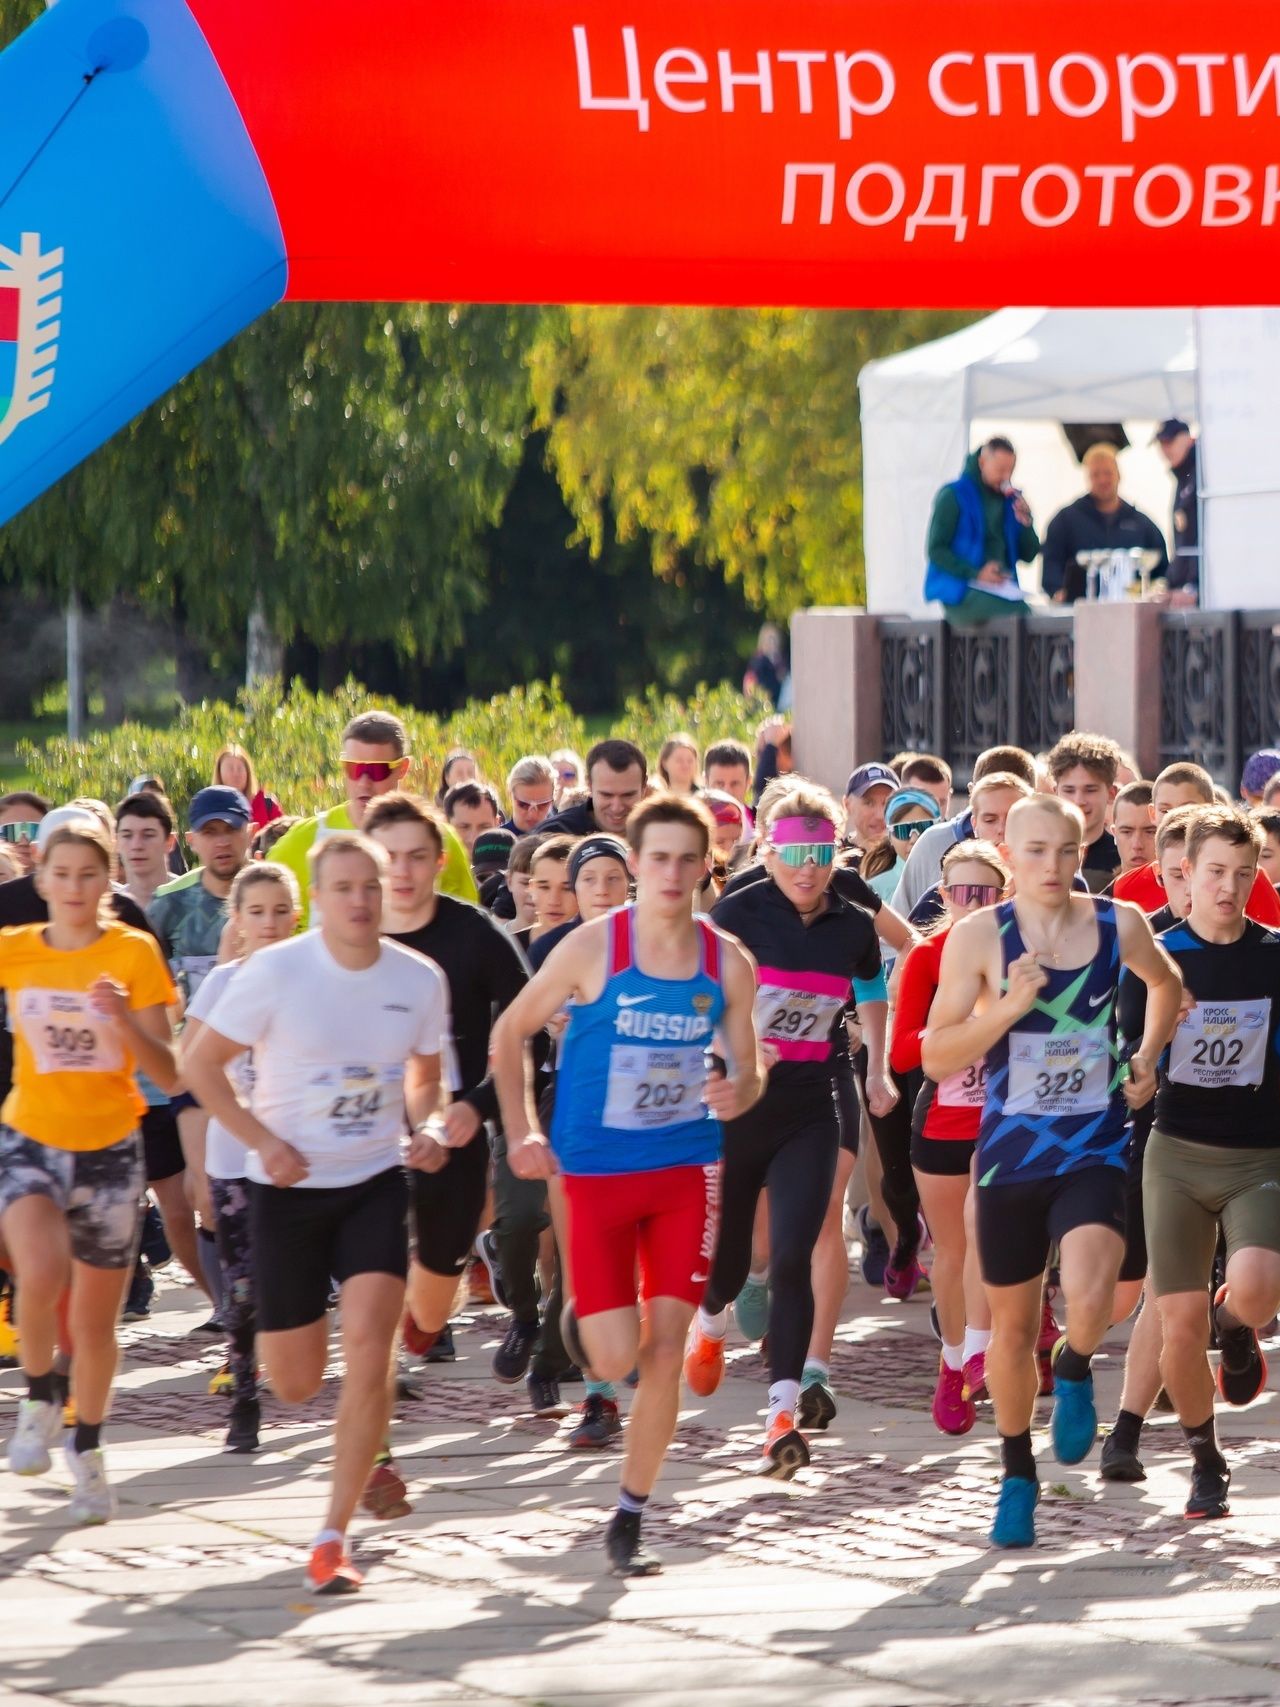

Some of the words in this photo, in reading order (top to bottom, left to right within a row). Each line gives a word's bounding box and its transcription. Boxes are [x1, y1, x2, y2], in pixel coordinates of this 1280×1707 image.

[573, 25, 896, 140] Центр
[614, 1008, 709, 1041] RUSSIA
[768, 1008, 818, 1036] 292
[1203, 1008, 1229, 1016] КРОСС
[1203, 1016, 1236, 1025] НАЦИИ
[1045, 1040, 1071, 1048] КРОСС
[1045, 1048, 1079, 1058] НАЦИИ
[1191, 1039, 1243, 1067] 202
[1034, 1068, 1086, 1099] 328
[1193, 1068, 1237, 1078] РЕСПУБЛИКА
[329, 1090, 380, 1119] 234
